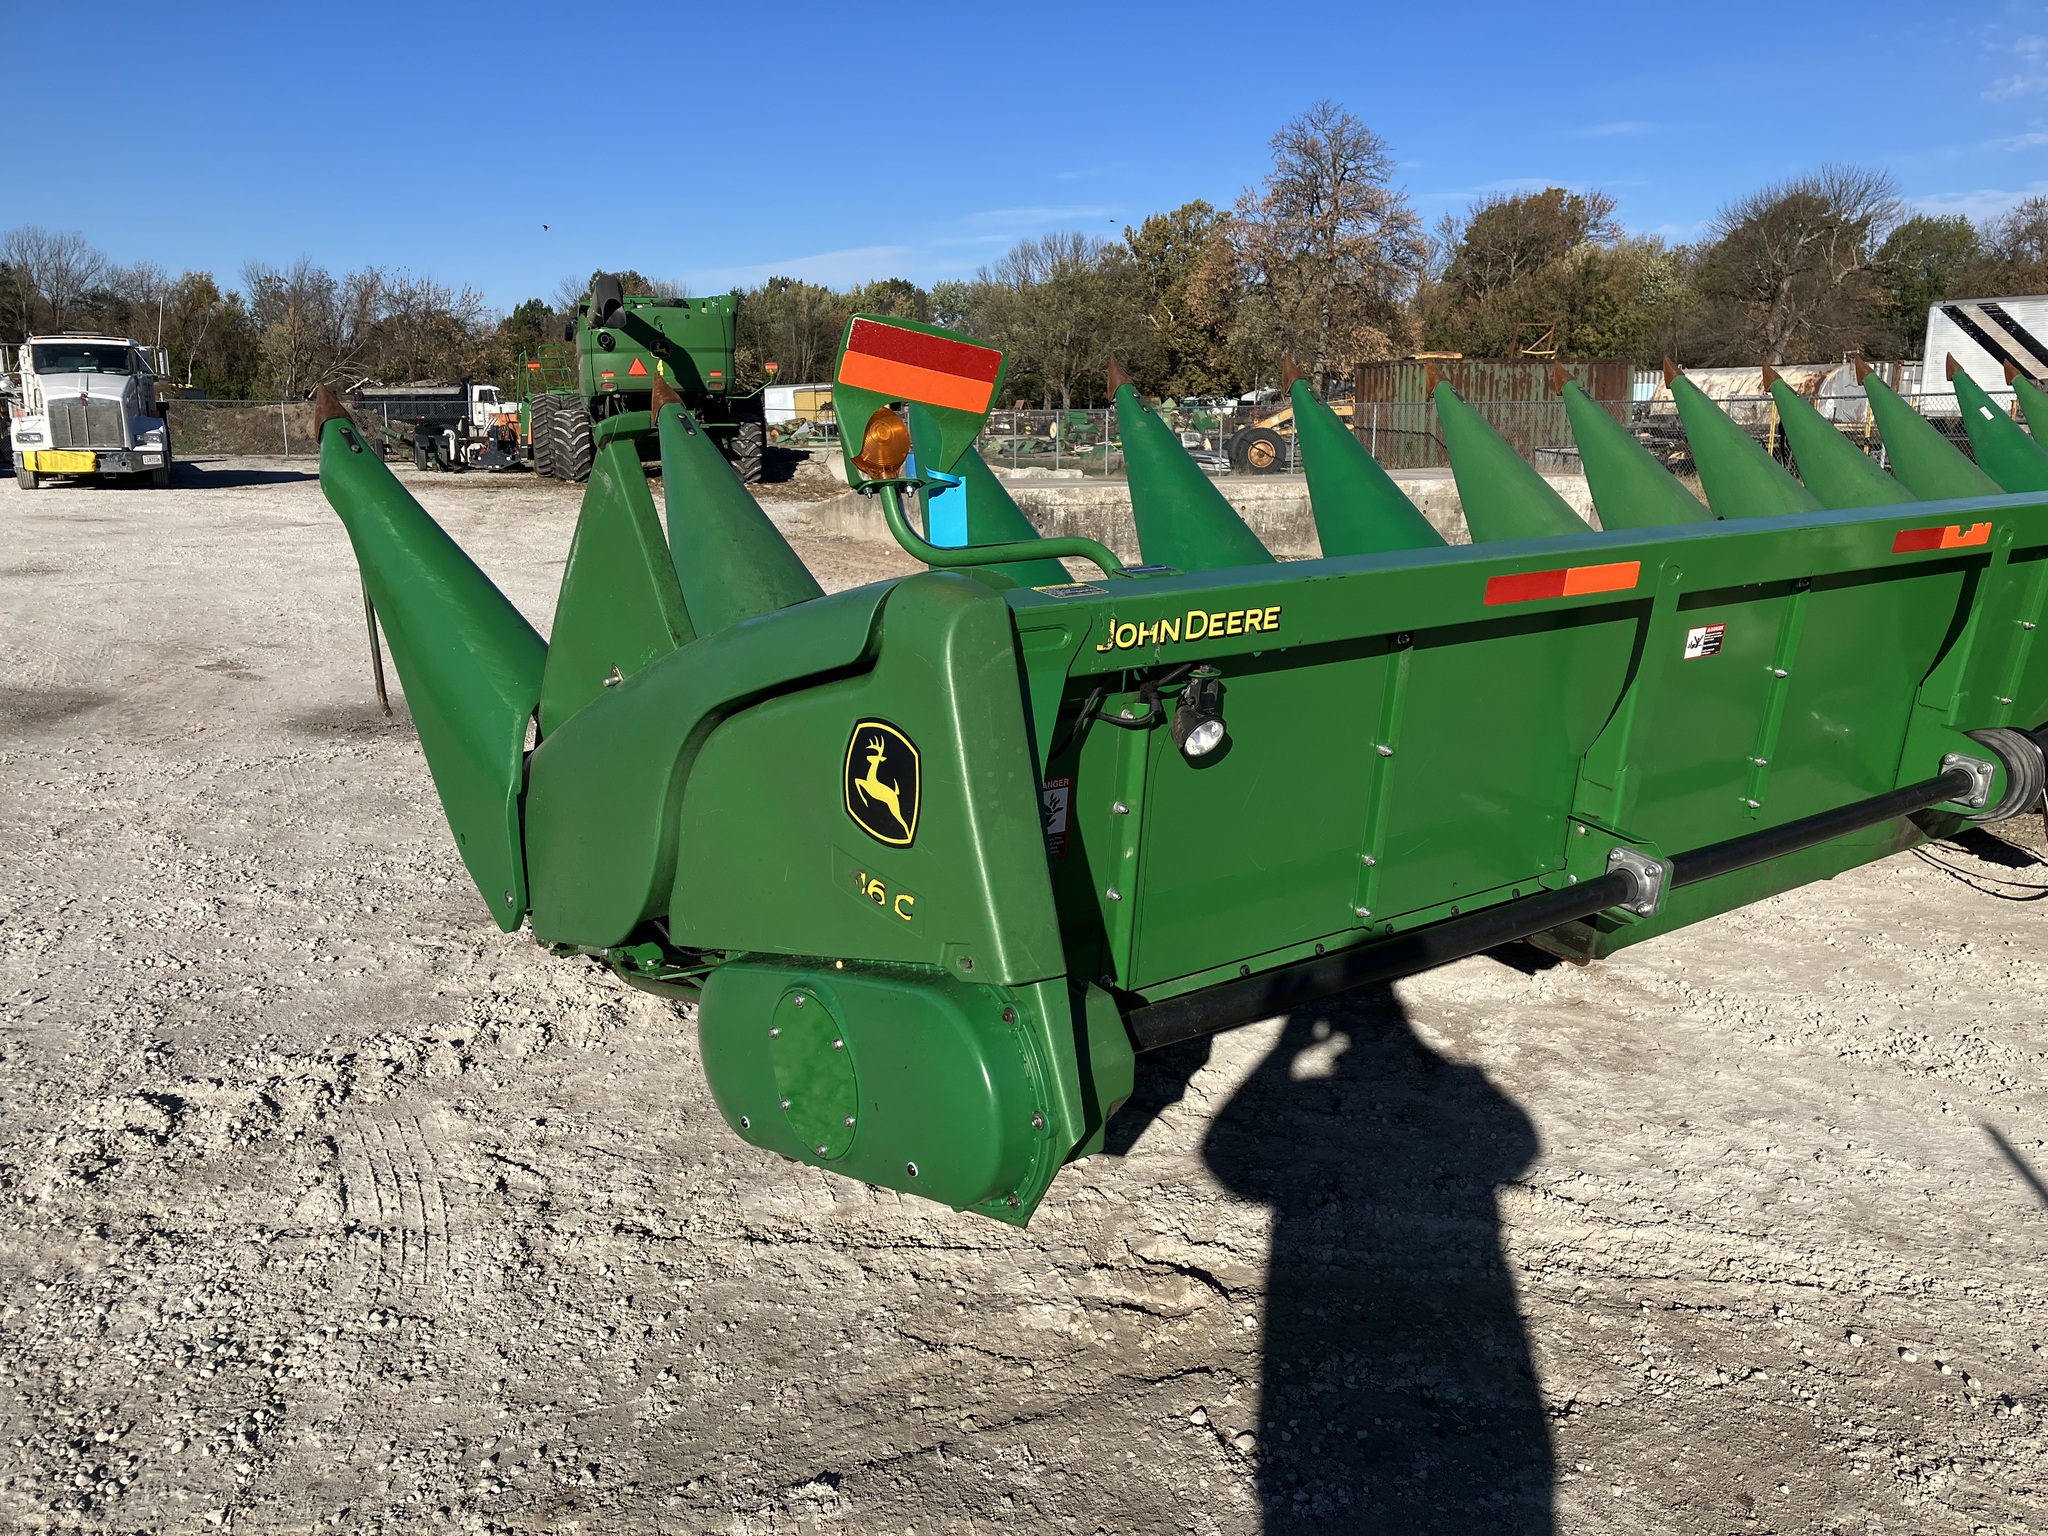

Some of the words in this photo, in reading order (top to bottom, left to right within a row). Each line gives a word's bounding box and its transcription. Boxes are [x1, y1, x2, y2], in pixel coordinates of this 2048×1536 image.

[1096, 617, 1182, 652] JOHN
[1184, 605, 1283, 643] DEERE
[1043, 778, 1070, 790] ANGER
